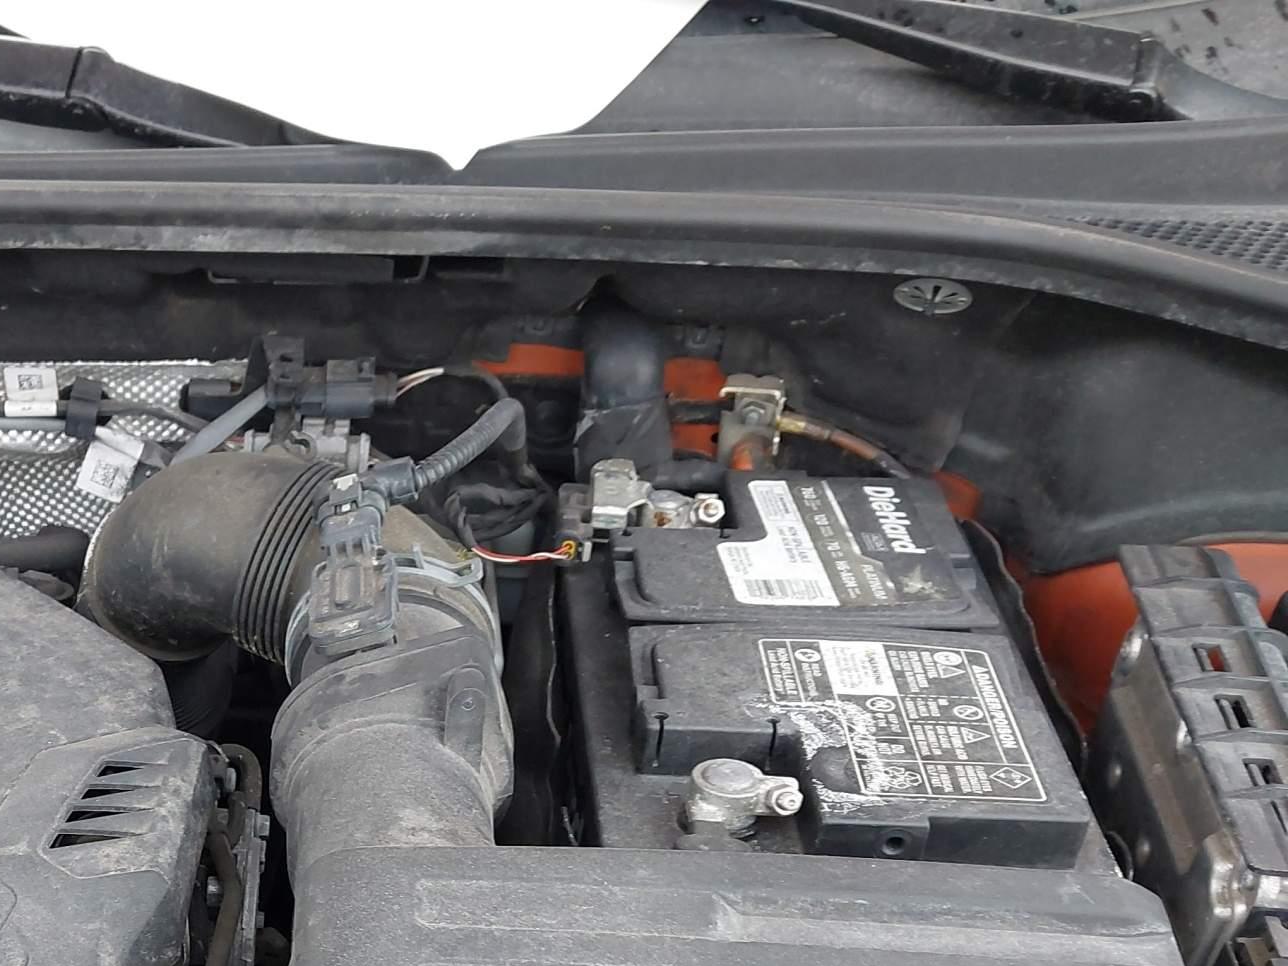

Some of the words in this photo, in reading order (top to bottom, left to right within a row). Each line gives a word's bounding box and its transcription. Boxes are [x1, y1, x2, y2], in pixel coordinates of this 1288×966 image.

[862, 485, 927, 554] DieHard
[861, 564, 889, 599] PLATINUM
[767, 650, 779, 662] Lead
[770, 663, 781, 674] Acid
[776, 648, 799, 695] NON-SPILLABLE
[811, 663, 822, 677] READ
[975, 673, 1019, 749] DANGER/POISON
[890, 744, 906, 754] DO
